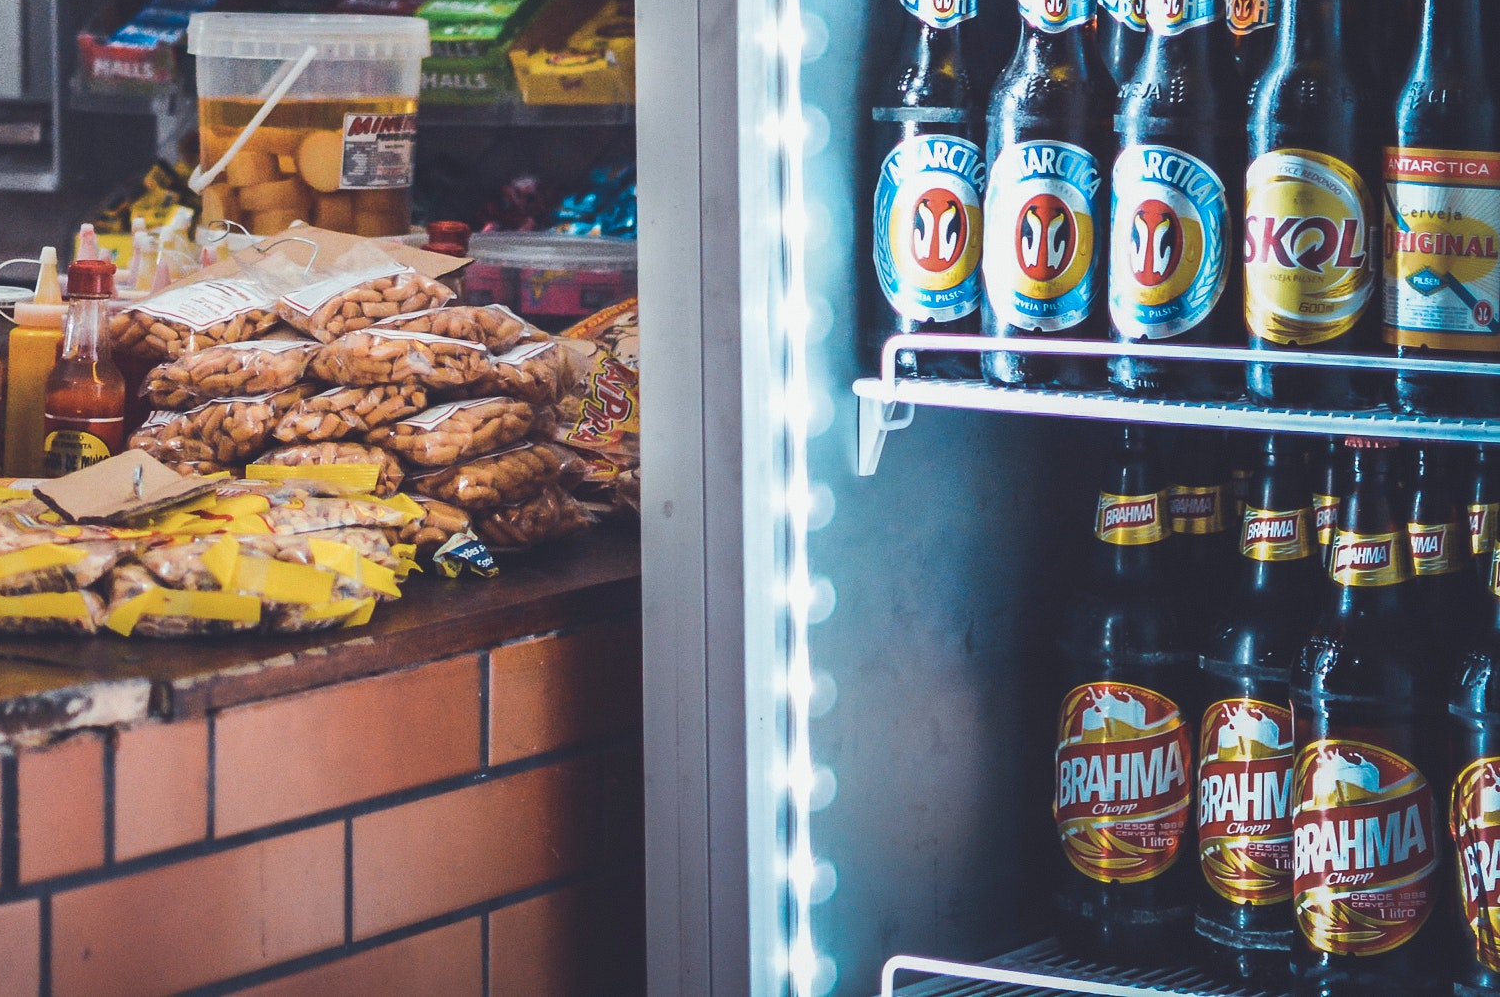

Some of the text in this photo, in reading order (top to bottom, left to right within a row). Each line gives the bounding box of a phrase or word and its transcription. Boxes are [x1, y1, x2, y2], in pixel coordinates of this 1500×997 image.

[1388, 156, 1491, 176] ANTARCTICA
[1301, 170, 1343, 196] REDONDO
[1400, 203, 1463, 222] Cerveja
[1244, 214, 1367, 274] SKOL
[1384, 222, 1499, 261] ORIGINAL
[1293, 273, 1325, 284] PILSEN
[1412, 275, 1441, 287] PILSEN
[1298, 302, 1334, 315] 600ml
[1104, 498, 1153, 527] BRAHMA
[1246, 518, 1295, 542] BRAHMA
[1059, 740, 1186, 809] BRAHMA
[1092, 802, 1138, 816] Chopp
[1115, 821, 1156, 831] DESDE
[1226, 821, 1271, 836] Chopp
[1115, 830, 1156, 838] CERVEJA
[1141, 836, 1175, 848] 1 litro
[1249, 843, 1289, 852] DESDE
[1294, 803, 1427, 881] BRAHMA
[1249, 851, 1290, 859] CERVEJA
[1325, 871, 1375, 886] Chopp
[1351, 892, 1394, 902] DESDE
[1379, 907, 1417, 919] 1 litro
